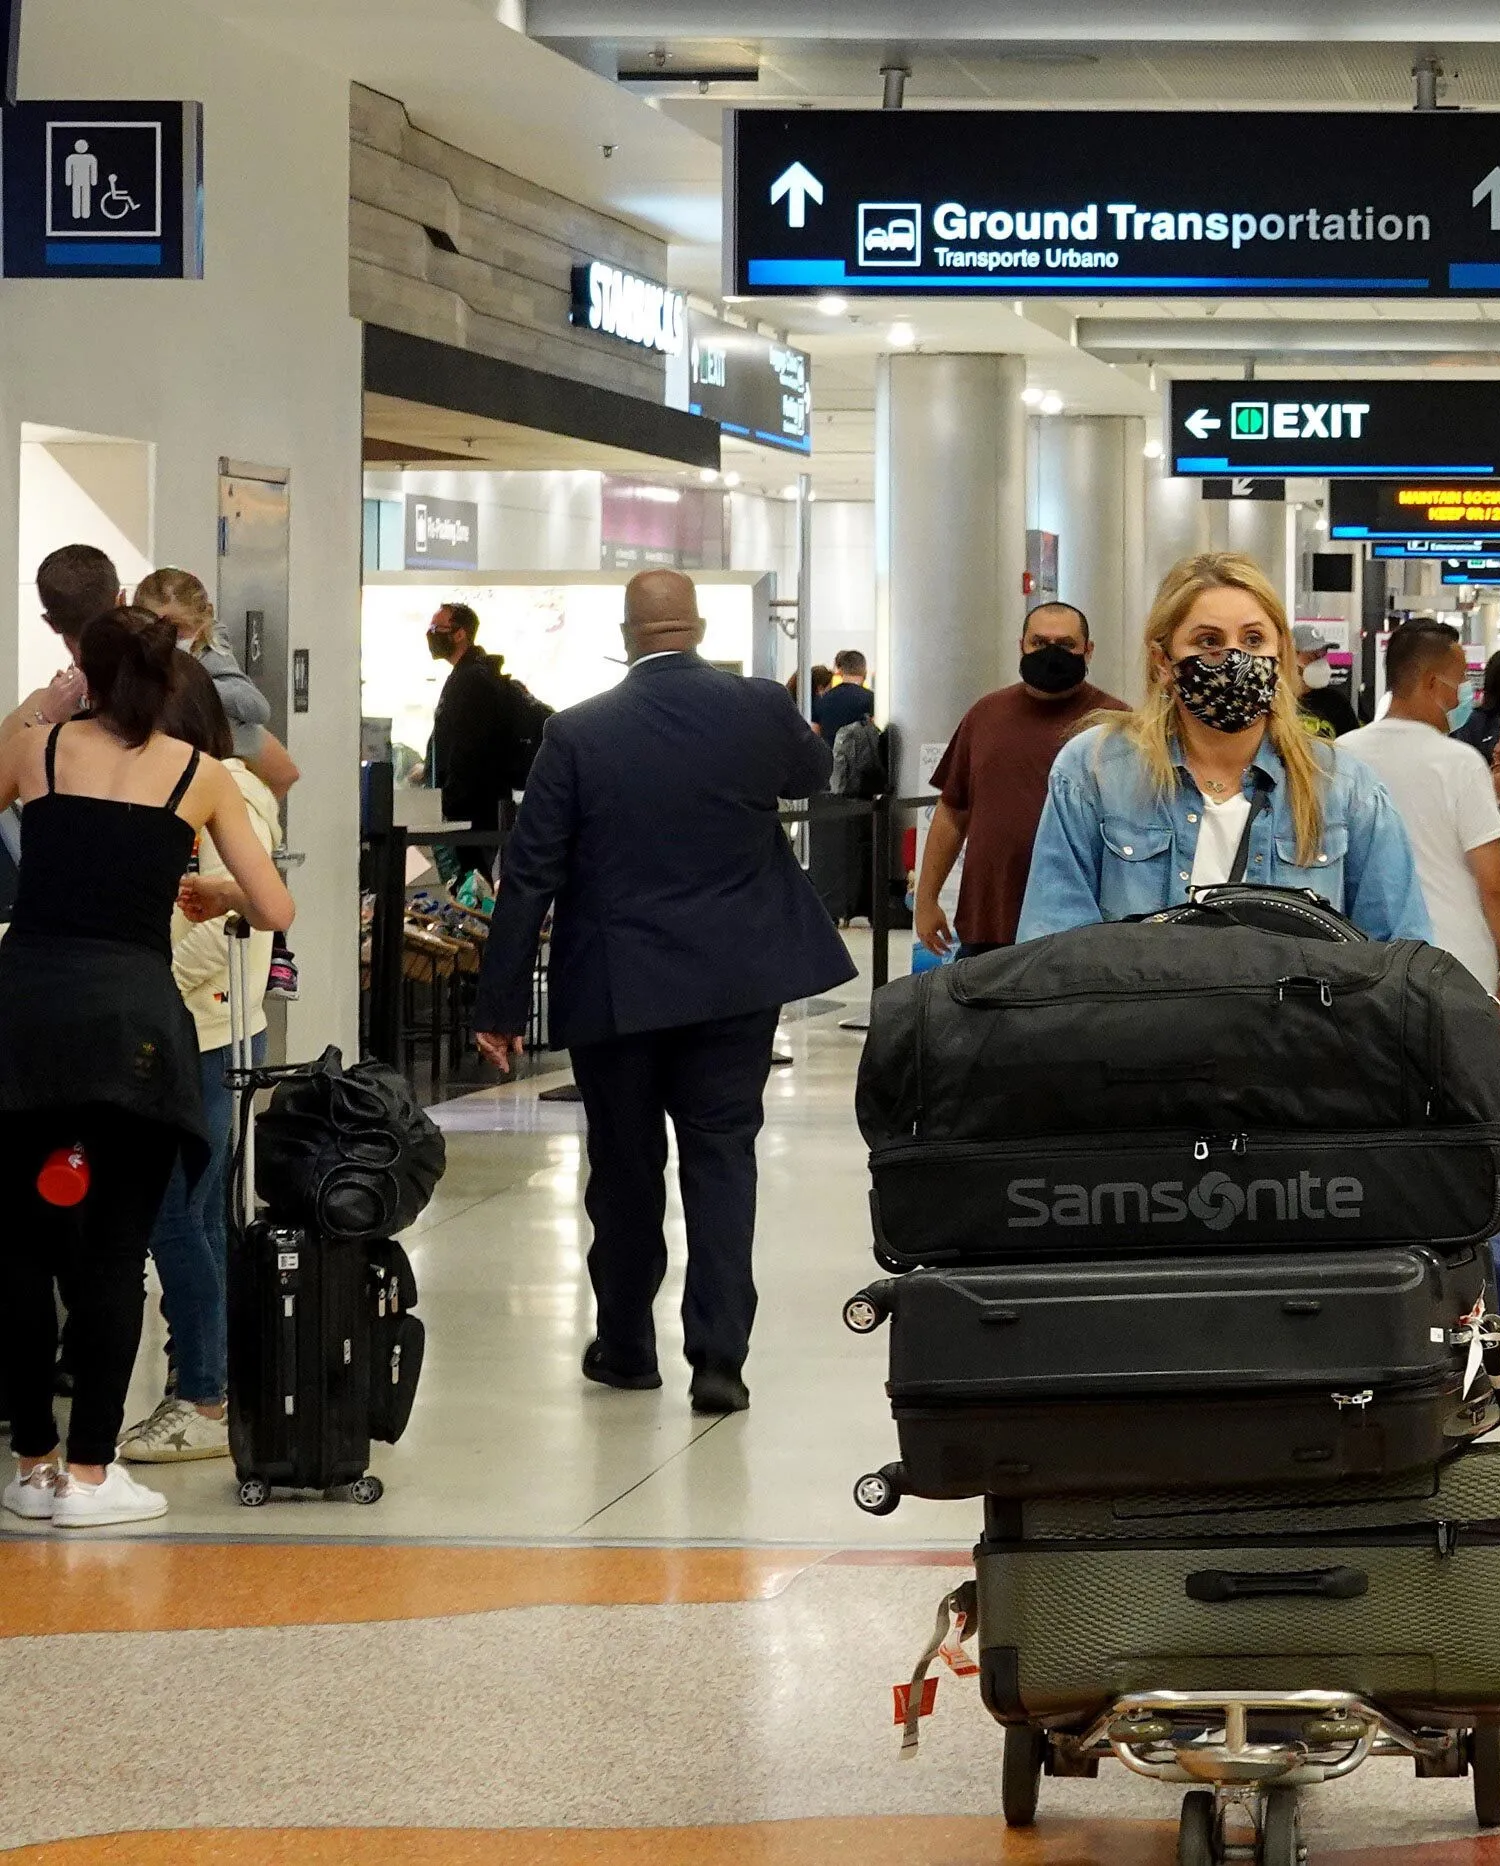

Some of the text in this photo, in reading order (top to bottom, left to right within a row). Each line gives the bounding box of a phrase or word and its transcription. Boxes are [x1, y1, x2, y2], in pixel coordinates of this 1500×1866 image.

[932, 202, 1431, 250] Ground Transportation
[933, 246, 1120, 272] Transporte Urbano
[1272, 403, 1370, 439] EXIT
[1399, 490, 1460, 505] MAINTAIN
[1007, 1170, 1363, 1231] Samsonite
